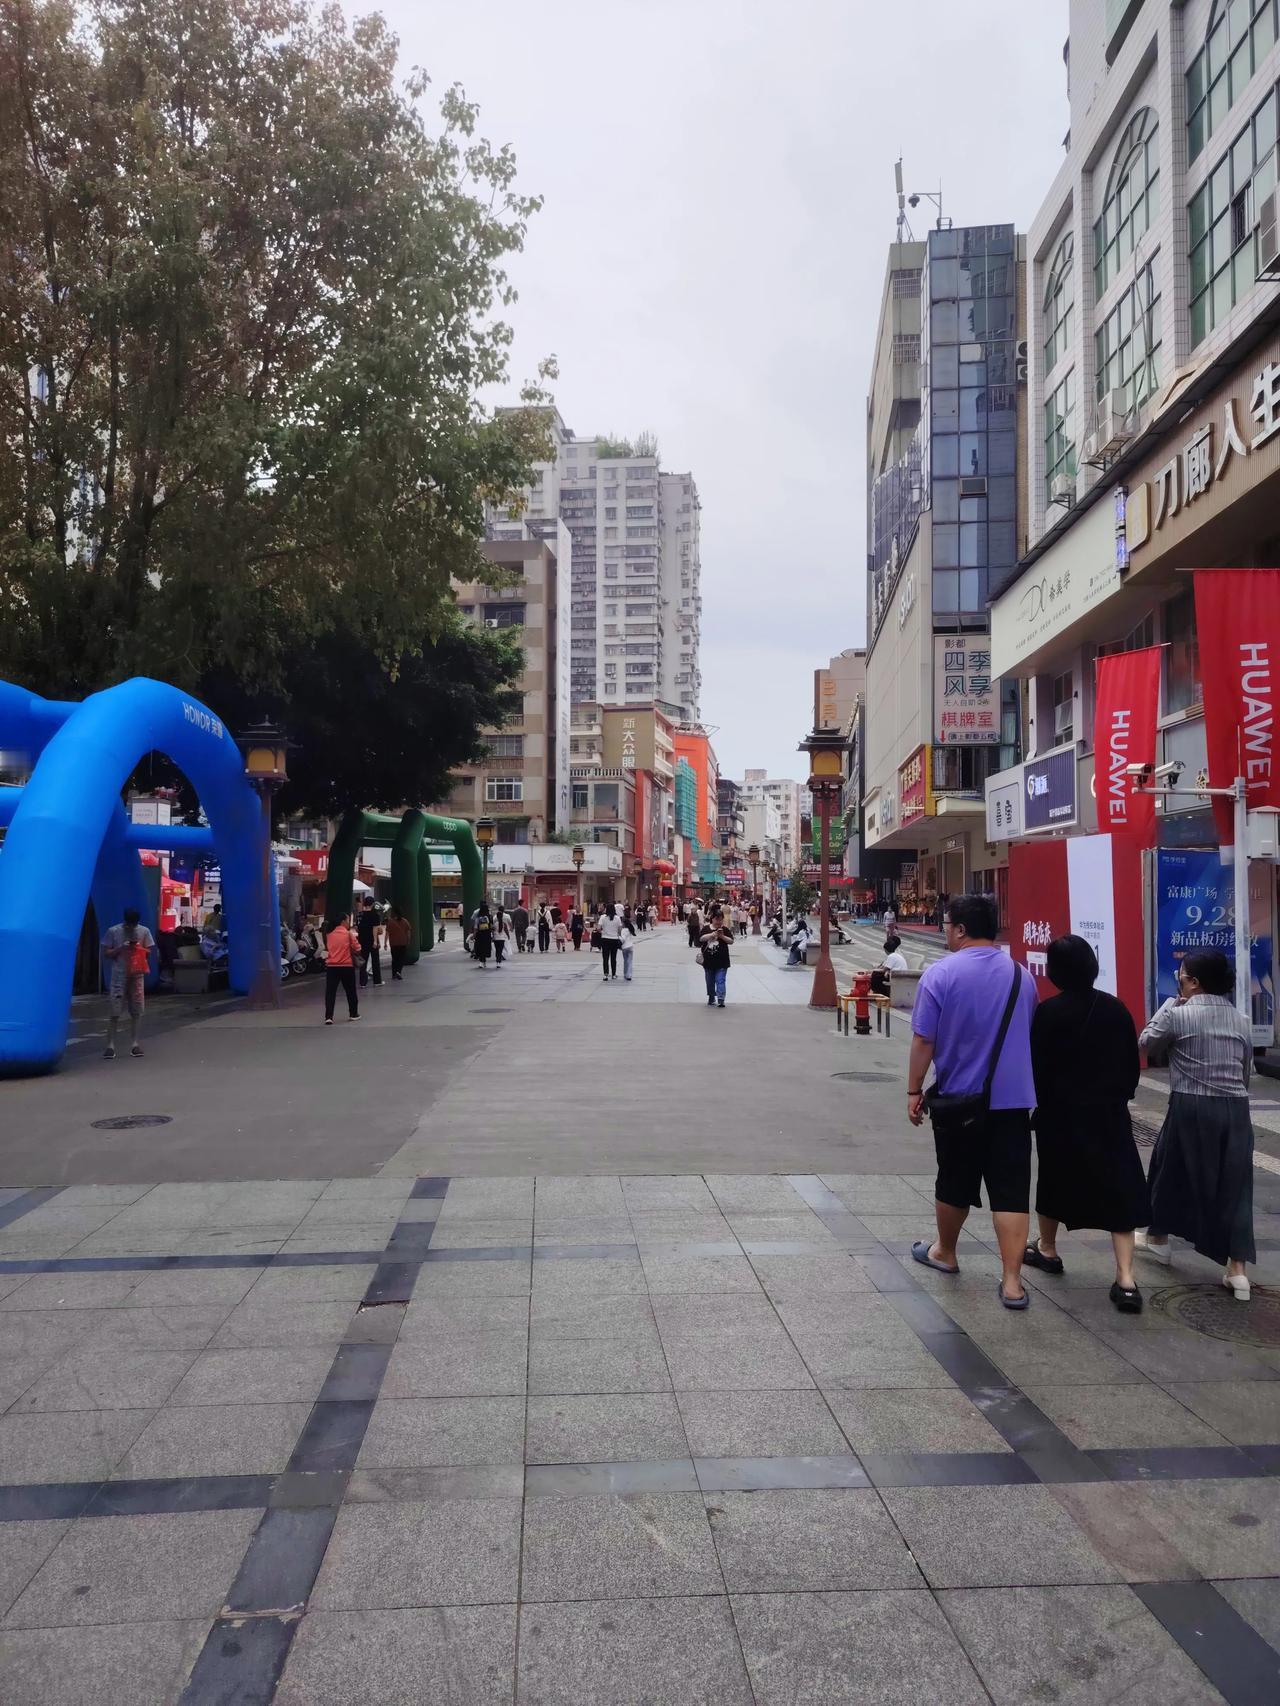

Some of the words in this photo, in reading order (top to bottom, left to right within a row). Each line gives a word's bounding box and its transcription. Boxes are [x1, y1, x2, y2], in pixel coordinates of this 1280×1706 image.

[944, 650, 991, 672] 四季
[943, 674, 992, 698] 风享
[182, 701, 211, 733] HONOR
[941, 711, 993, 728] 棋牌室
[1239, 642, 1273, 789] HUAWEI
[1108, 710, 1132, 824] HUAWEI
[1167, 885, 1218, 900] 富康广场
